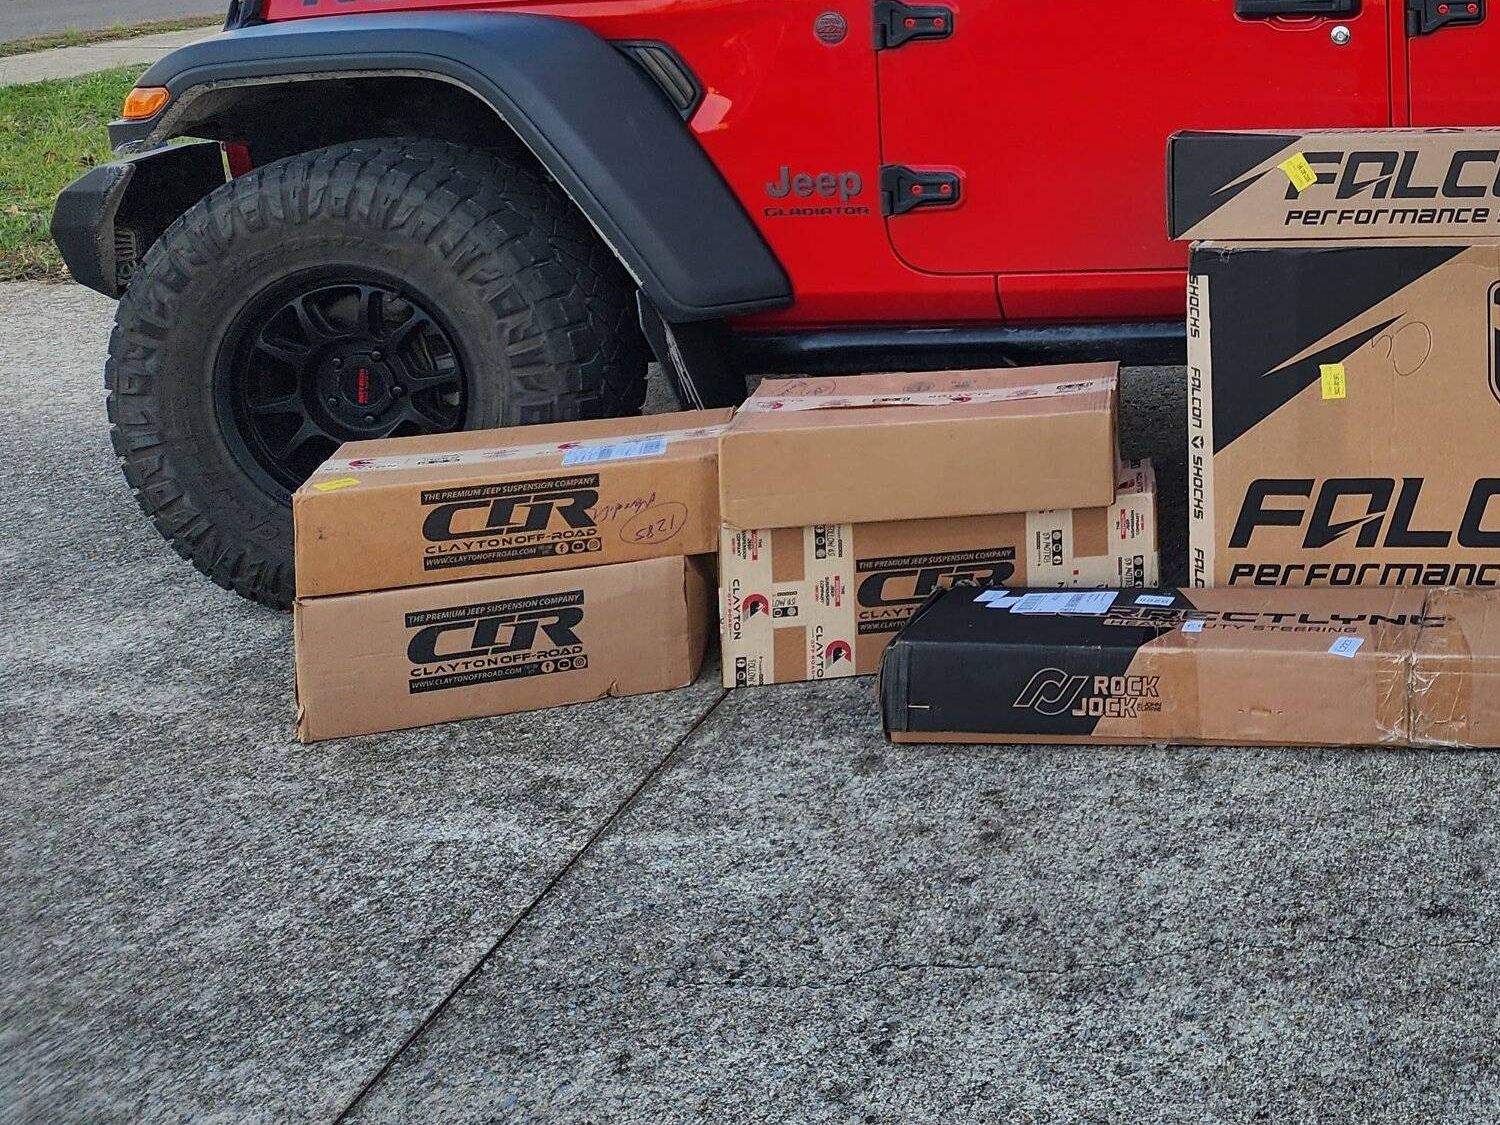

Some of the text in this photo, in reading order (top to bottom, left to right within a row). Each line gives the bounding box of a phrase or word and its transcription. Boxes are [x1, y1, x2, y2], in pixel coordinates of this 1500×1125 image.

[766, 166, 862, 202] Jeep
[764, 207, 870, 216] GLADIATOR
[1189, 275, 1200, 339] SHOCKS
[1191, 367, 1202, 428] FALCON
[424, 477, 596, 501] THE PREMIUM JEEP SUSPENSION COMPANY
[1192, 455, 1204, 520] SHOCKS
[426, 548, 536, 567] WWW.CLAYTONOFFROAD.COM
[859, 549, 1012, 570] THE PREMIUM JEEP SUSPENSION COMPANY
[1194, 547, 1205, 588] FALC
[408, 594, 580, 624] THE PREMIUM JEEP SUSPENSION COMPANY
[732, 578, 742, 640] CLAYTON
[1104, 606, 1446, 629] RRECTLYNC
[1204, 623, 1245, 631] UTY
[1252, 625, 1357, 633] STEERING
[411, 668, 522, 689] WWW.CLAYTONOFFROAD.COM
[1094, 675, 1160, 698] ROCK
[1072, 697, 1138, 718] JOCK
